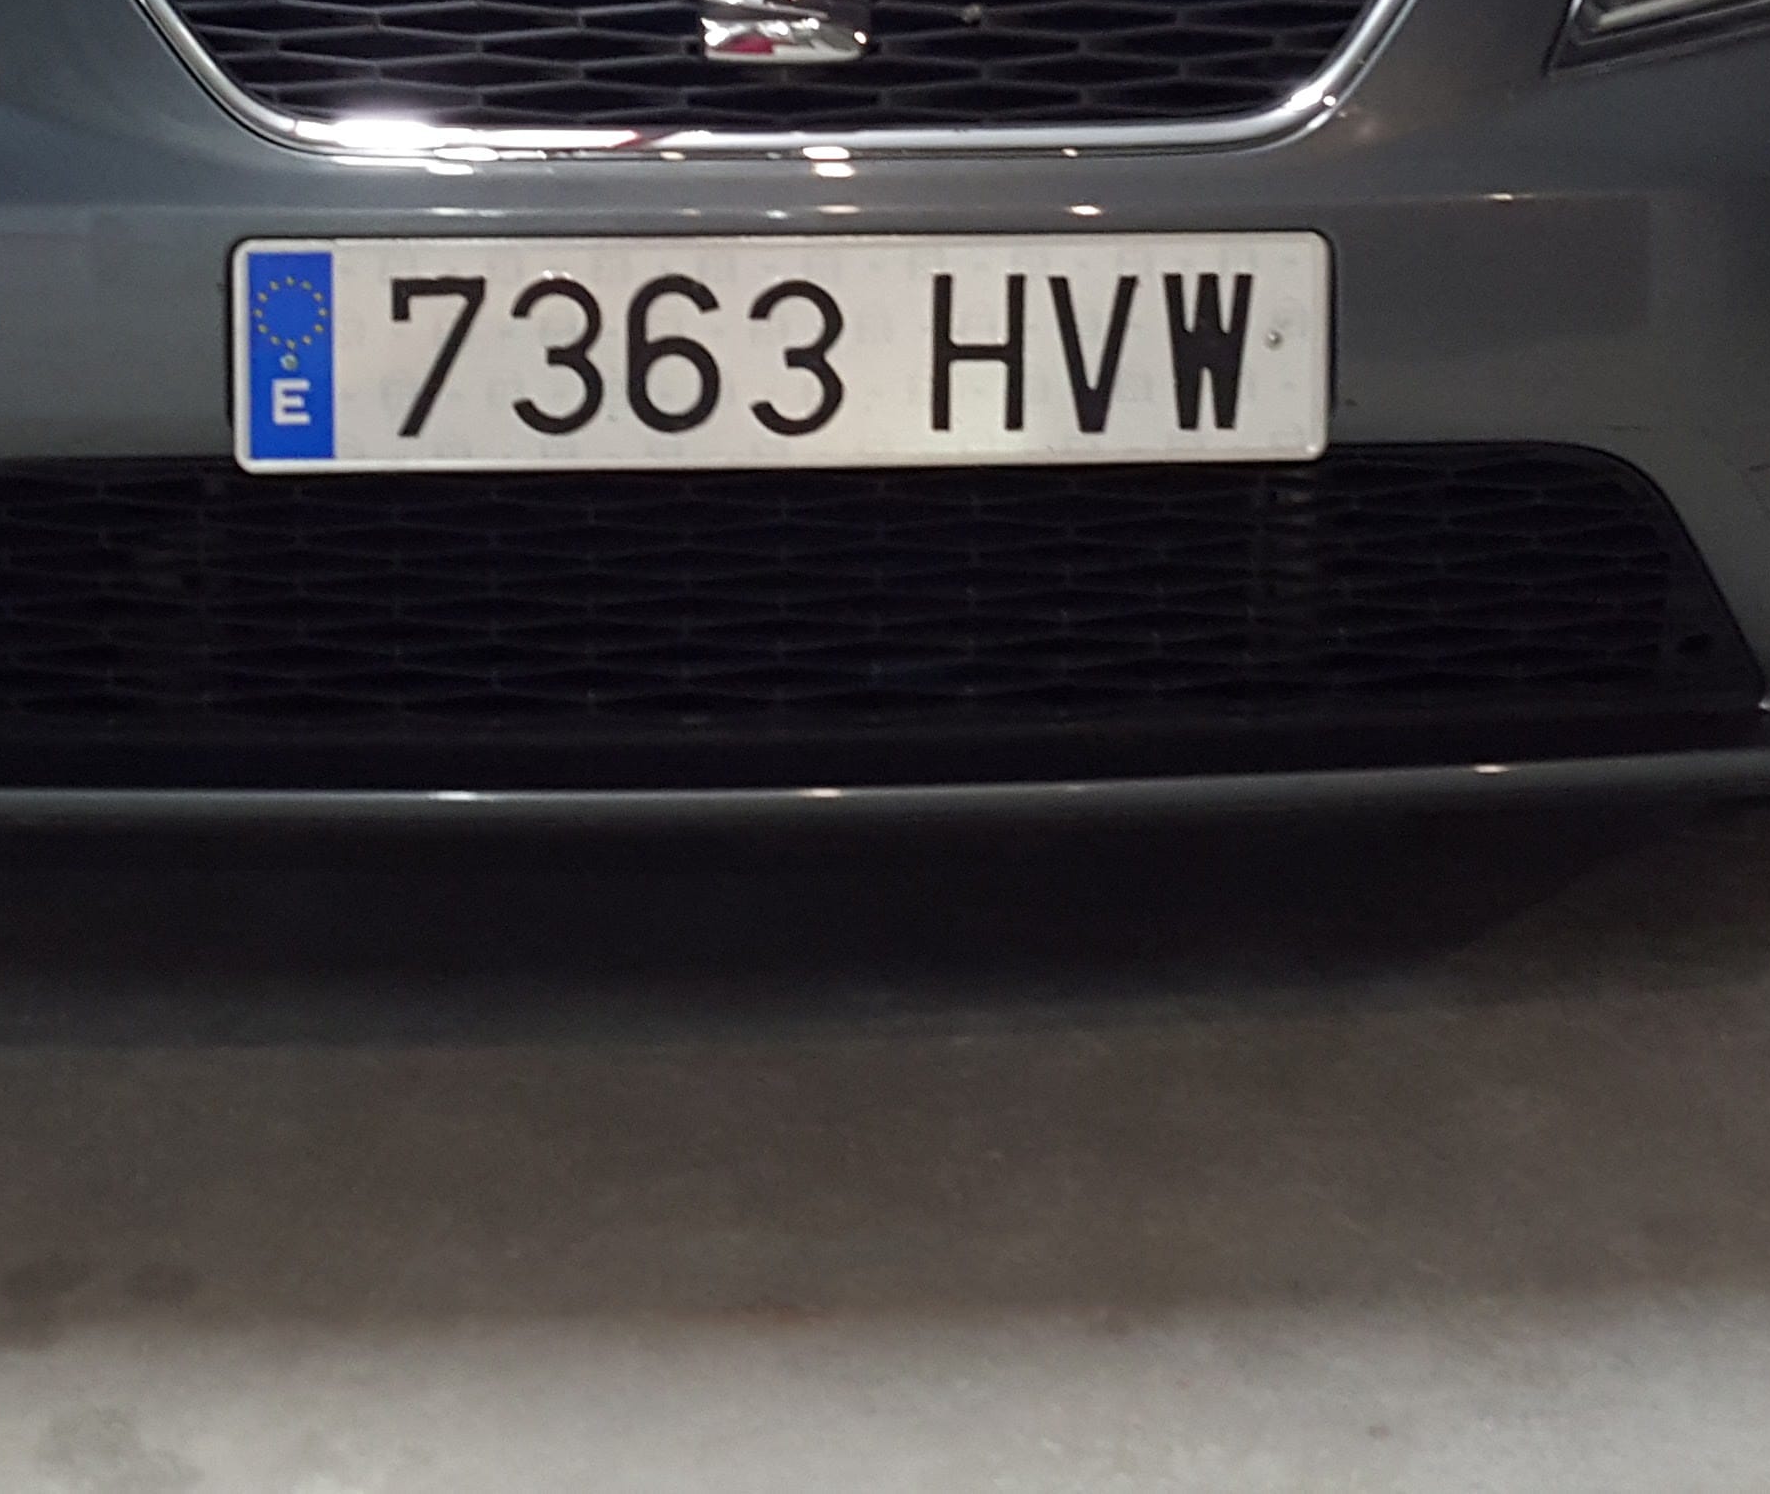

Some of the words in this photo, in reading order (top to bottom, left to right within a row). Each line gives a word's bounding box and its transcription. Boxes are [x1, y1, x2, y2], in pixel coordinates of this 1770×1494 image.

[271, 378, 311, 426] E
[391, 273, 845, 438] 7363
[931, 272, 1255, 434] HVW
